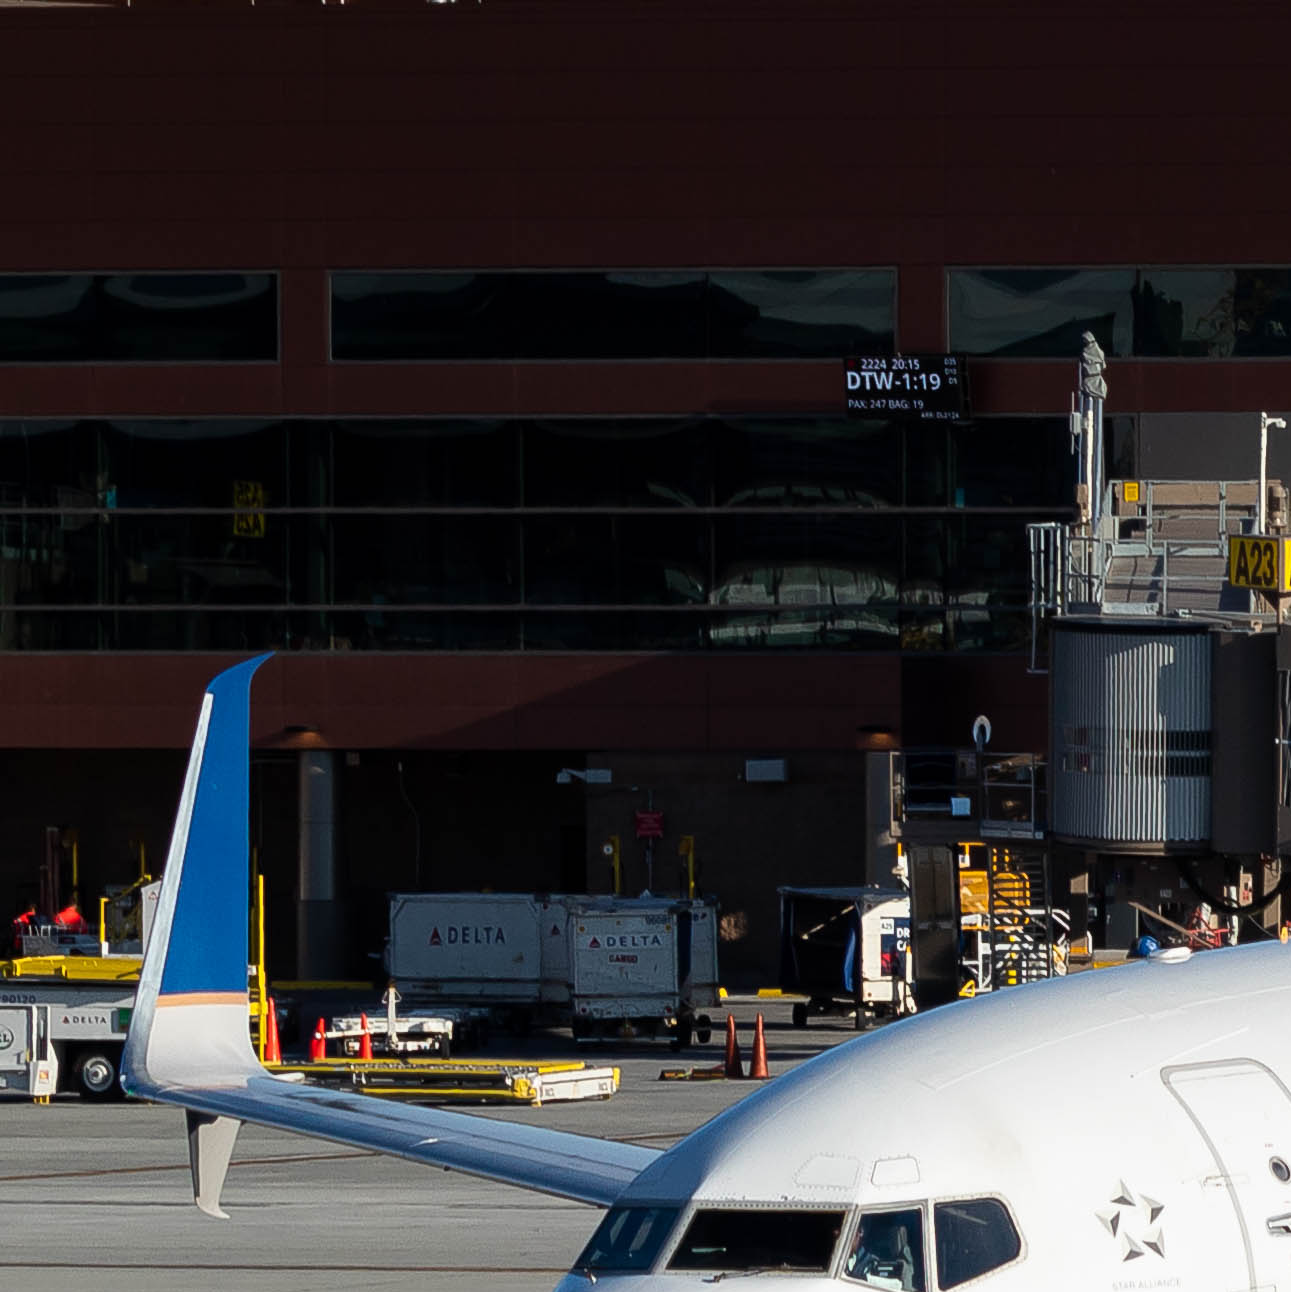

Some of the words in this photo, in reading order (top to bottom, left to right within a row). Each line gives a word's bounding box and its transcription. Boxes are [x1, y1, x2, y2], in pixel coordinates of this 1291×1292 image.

[861, 358, 888, 370] 2224
[892, 358, 920, 370] 20:15
[847, 371, 941, 390] DTW-1:19
[870, 400, 886, 409] 247
[914, 400, 924, 409] 19
[1235, 541, 1274, 586] A23
[448, 926, 506, 944] DELTA
[606, 934, 662, 947] DELTA
[72, 1015, 108, 1025] DELTA
